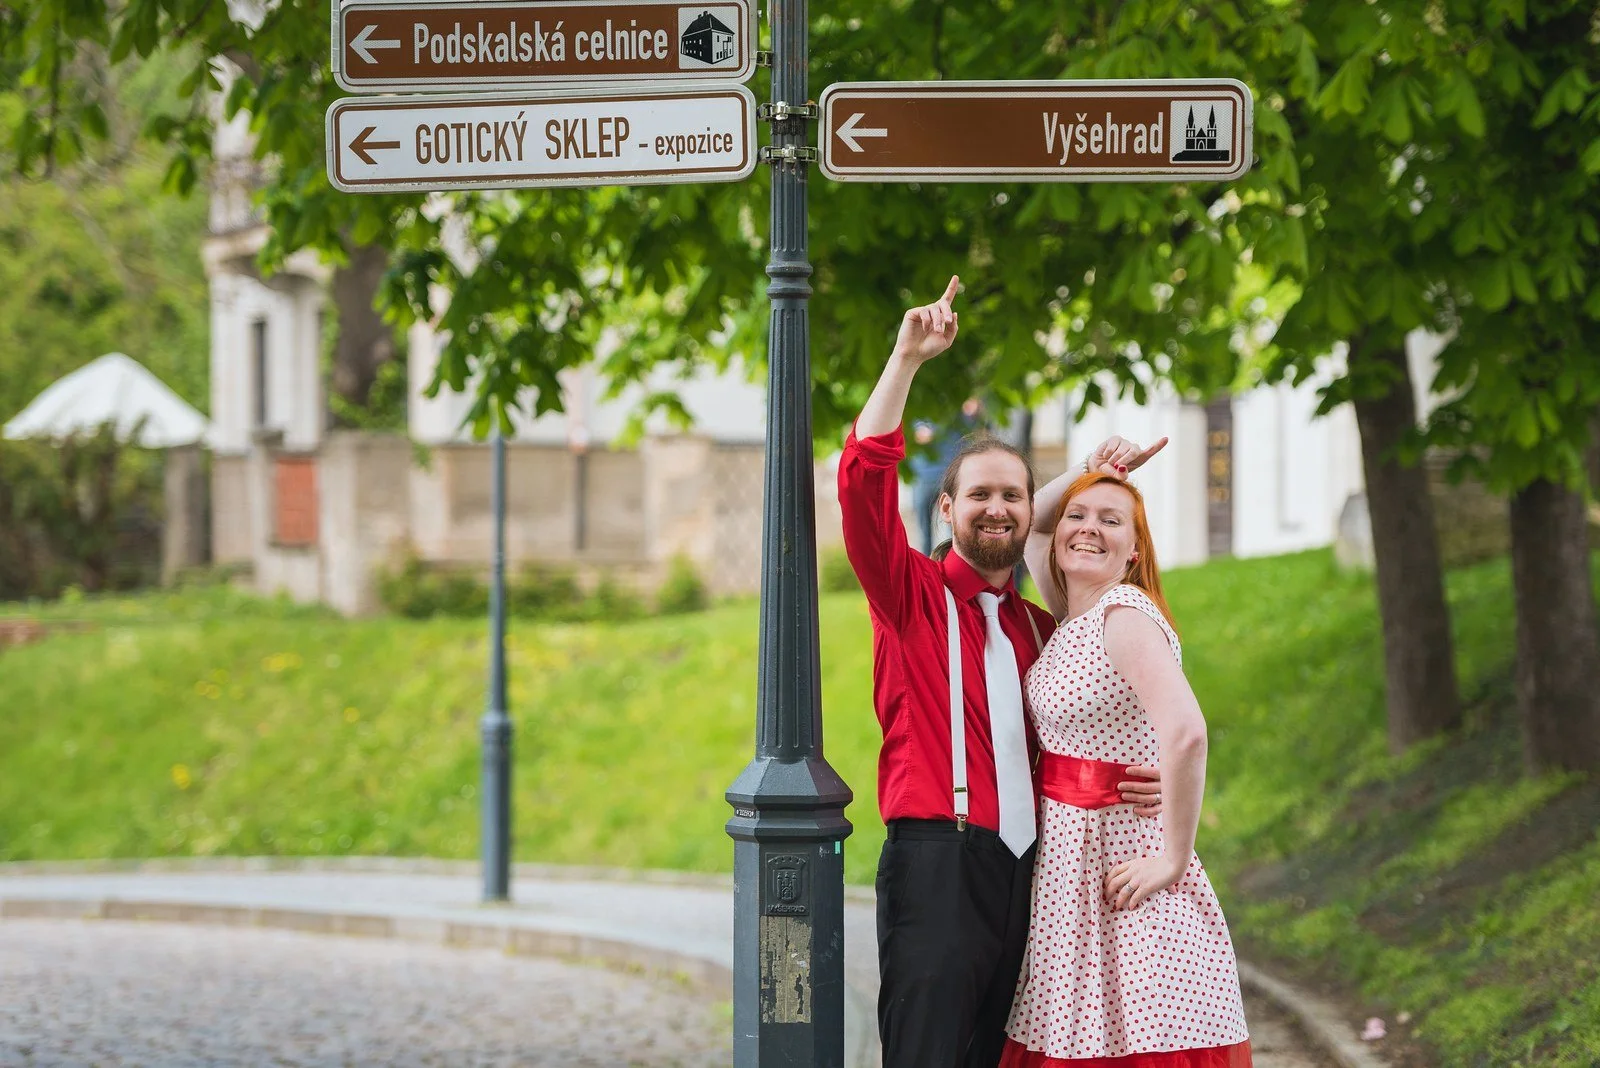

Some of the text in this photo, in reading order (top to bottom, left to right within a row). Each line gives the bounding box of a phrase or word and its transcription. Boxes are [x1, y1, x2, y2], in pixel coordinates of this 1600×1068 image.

[413, 19, 669, 65] Podskalská celnice
[414, 110, 528, 165] GOTICKÝ
[545, 116, 630, 160] SKLEP
[655, 126, 733, 162] expozice
[1042, 111, 1164, 165] Vyšehrad
